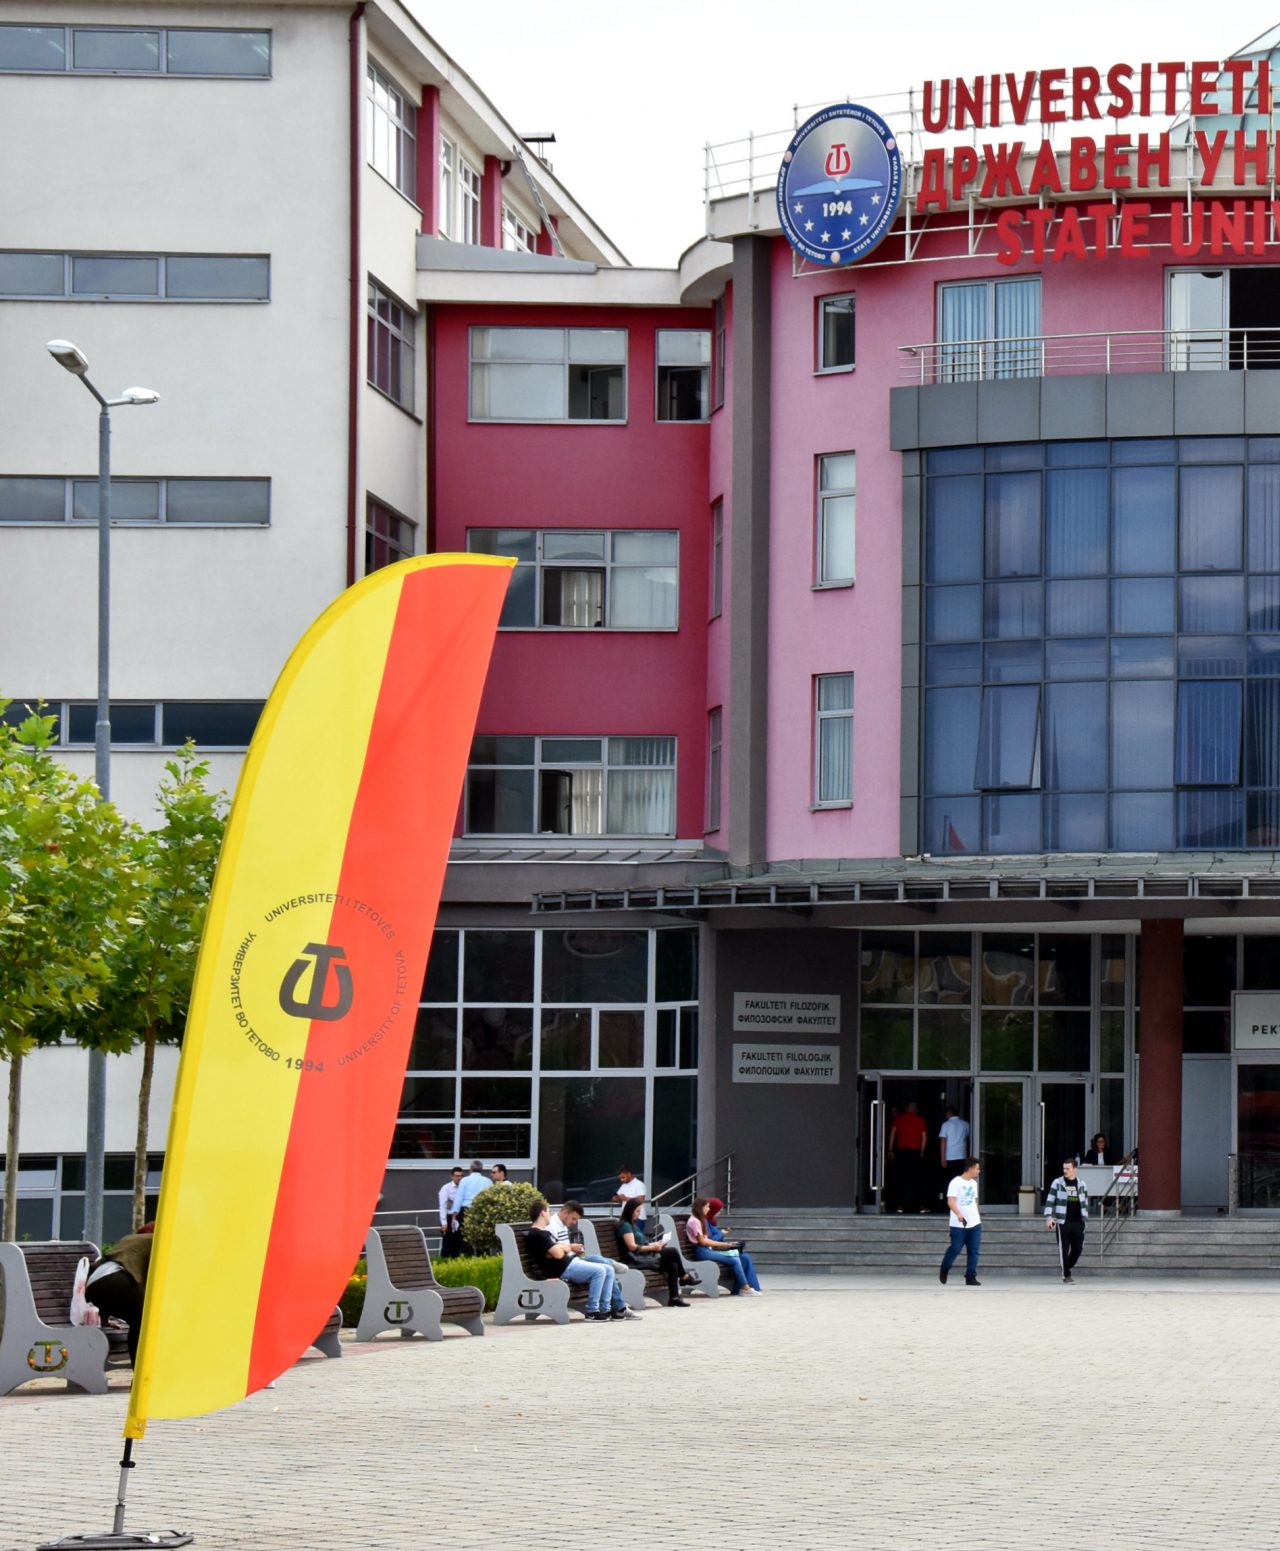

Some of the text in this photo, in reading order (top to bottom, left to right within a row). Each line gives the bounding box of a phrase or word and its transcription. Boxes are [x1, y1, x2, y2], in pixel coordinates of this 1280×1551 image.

[922, 59, 1271, 134] UNIVERSITETI
[916, 132, 1170, 213] ДРЖАВЕН
[822, 201, 853, 218] 1994
[995, 200, 1151, 267] STATE
[264, 893, 344, 923] UNIVERSITETI
[230, 931, 257, 1010] УНИВЕРЗИТЕТ
[336, 950, 407, 1067] UNIVERSITY OF TETOVA
[745, 1000, 830, 1011] FAKULTETI FILOZOFIK
[285, 1057, 325, 1073] 1994
[741, 1051, 832, 1062] FAKULTETI FILOLOGJIK
